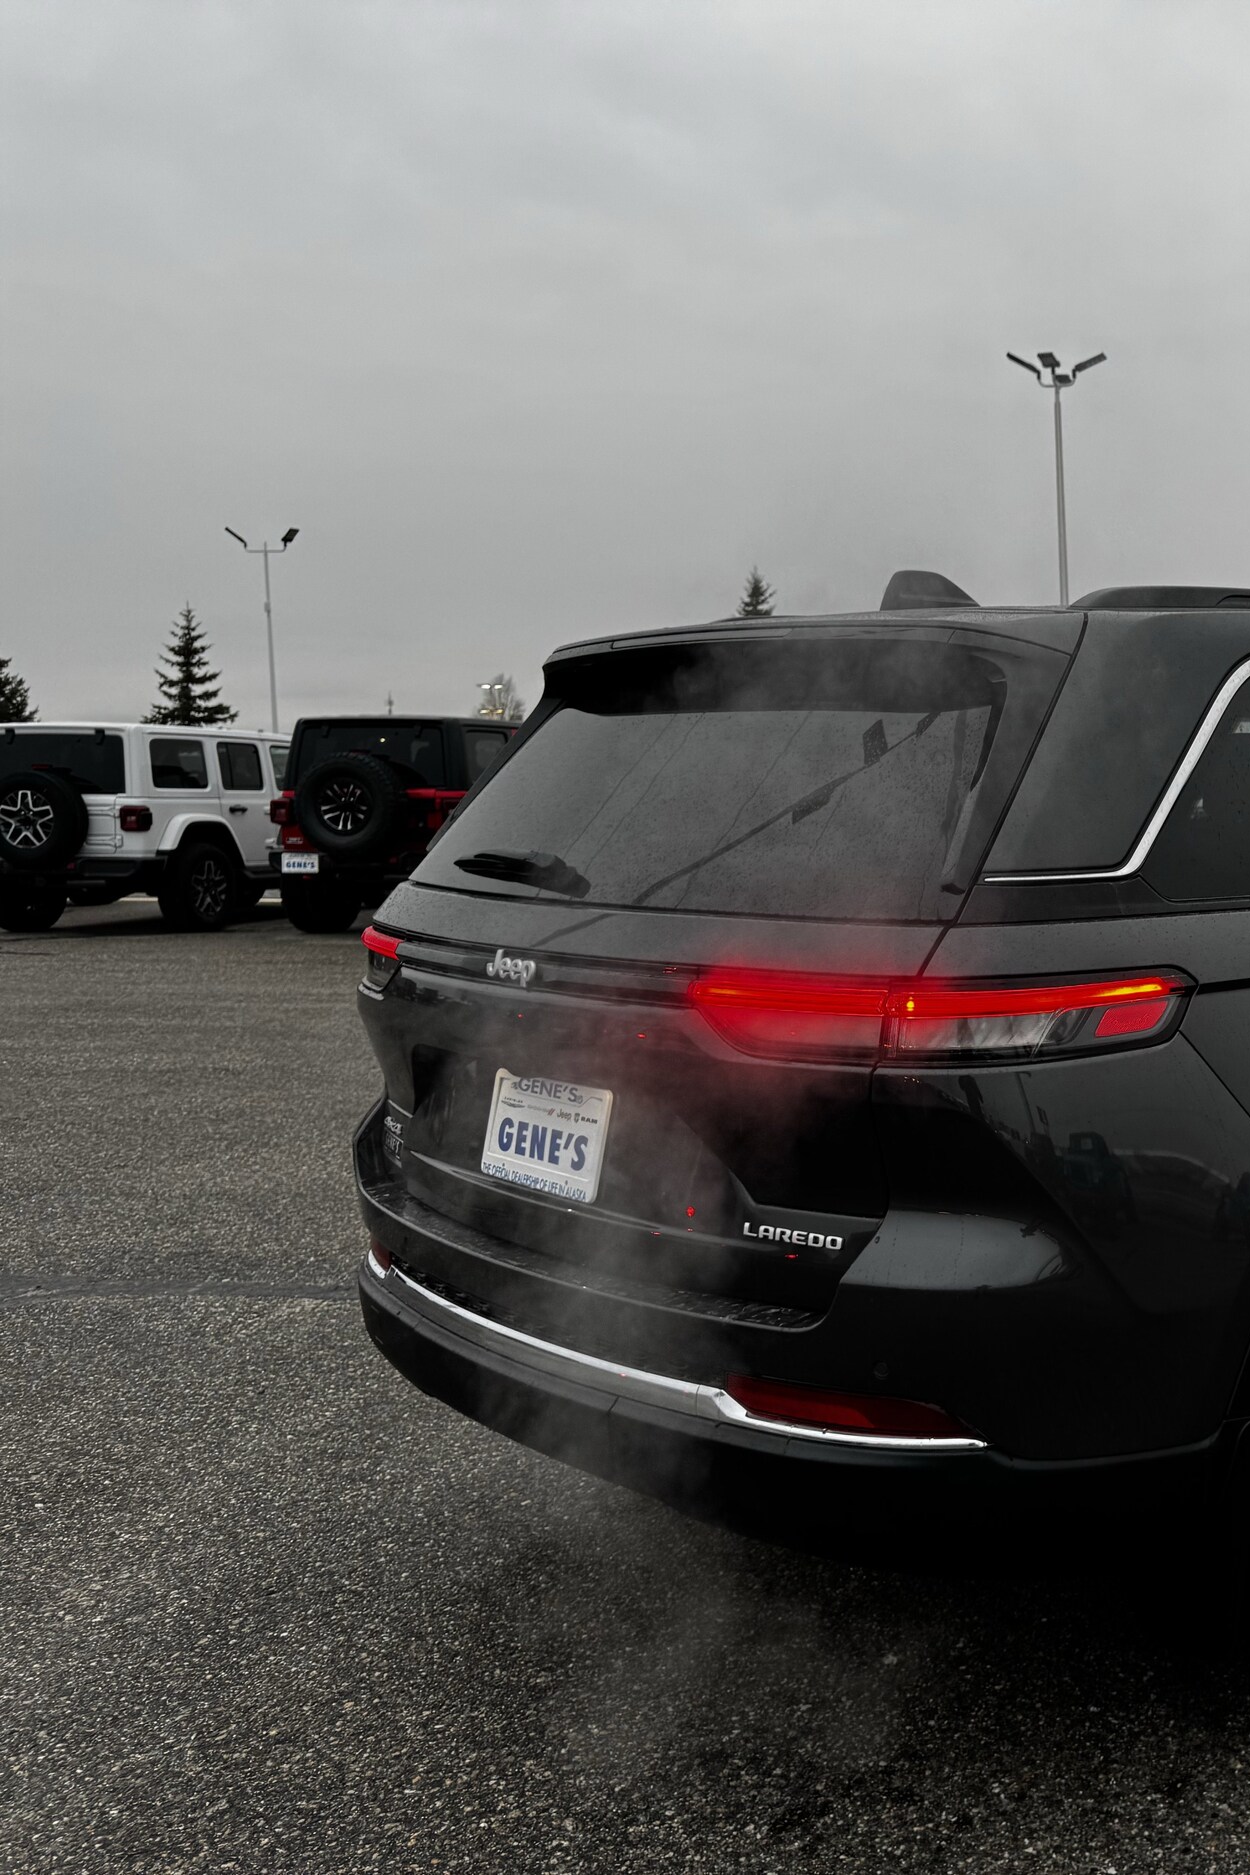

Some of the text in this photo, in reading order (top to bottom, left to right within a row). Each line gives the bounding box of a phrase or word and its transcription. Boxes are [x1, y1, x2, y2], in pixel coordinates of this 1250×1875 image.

[286, 861, 315, 869] GENE'S
[486, 949, 536, 987] Jeep
[518, 1078, 579, 1104] GENE'S
[497, 1117, 589, 1171] GENE'S
[743, 1222, 843, 1250] LAREDO
